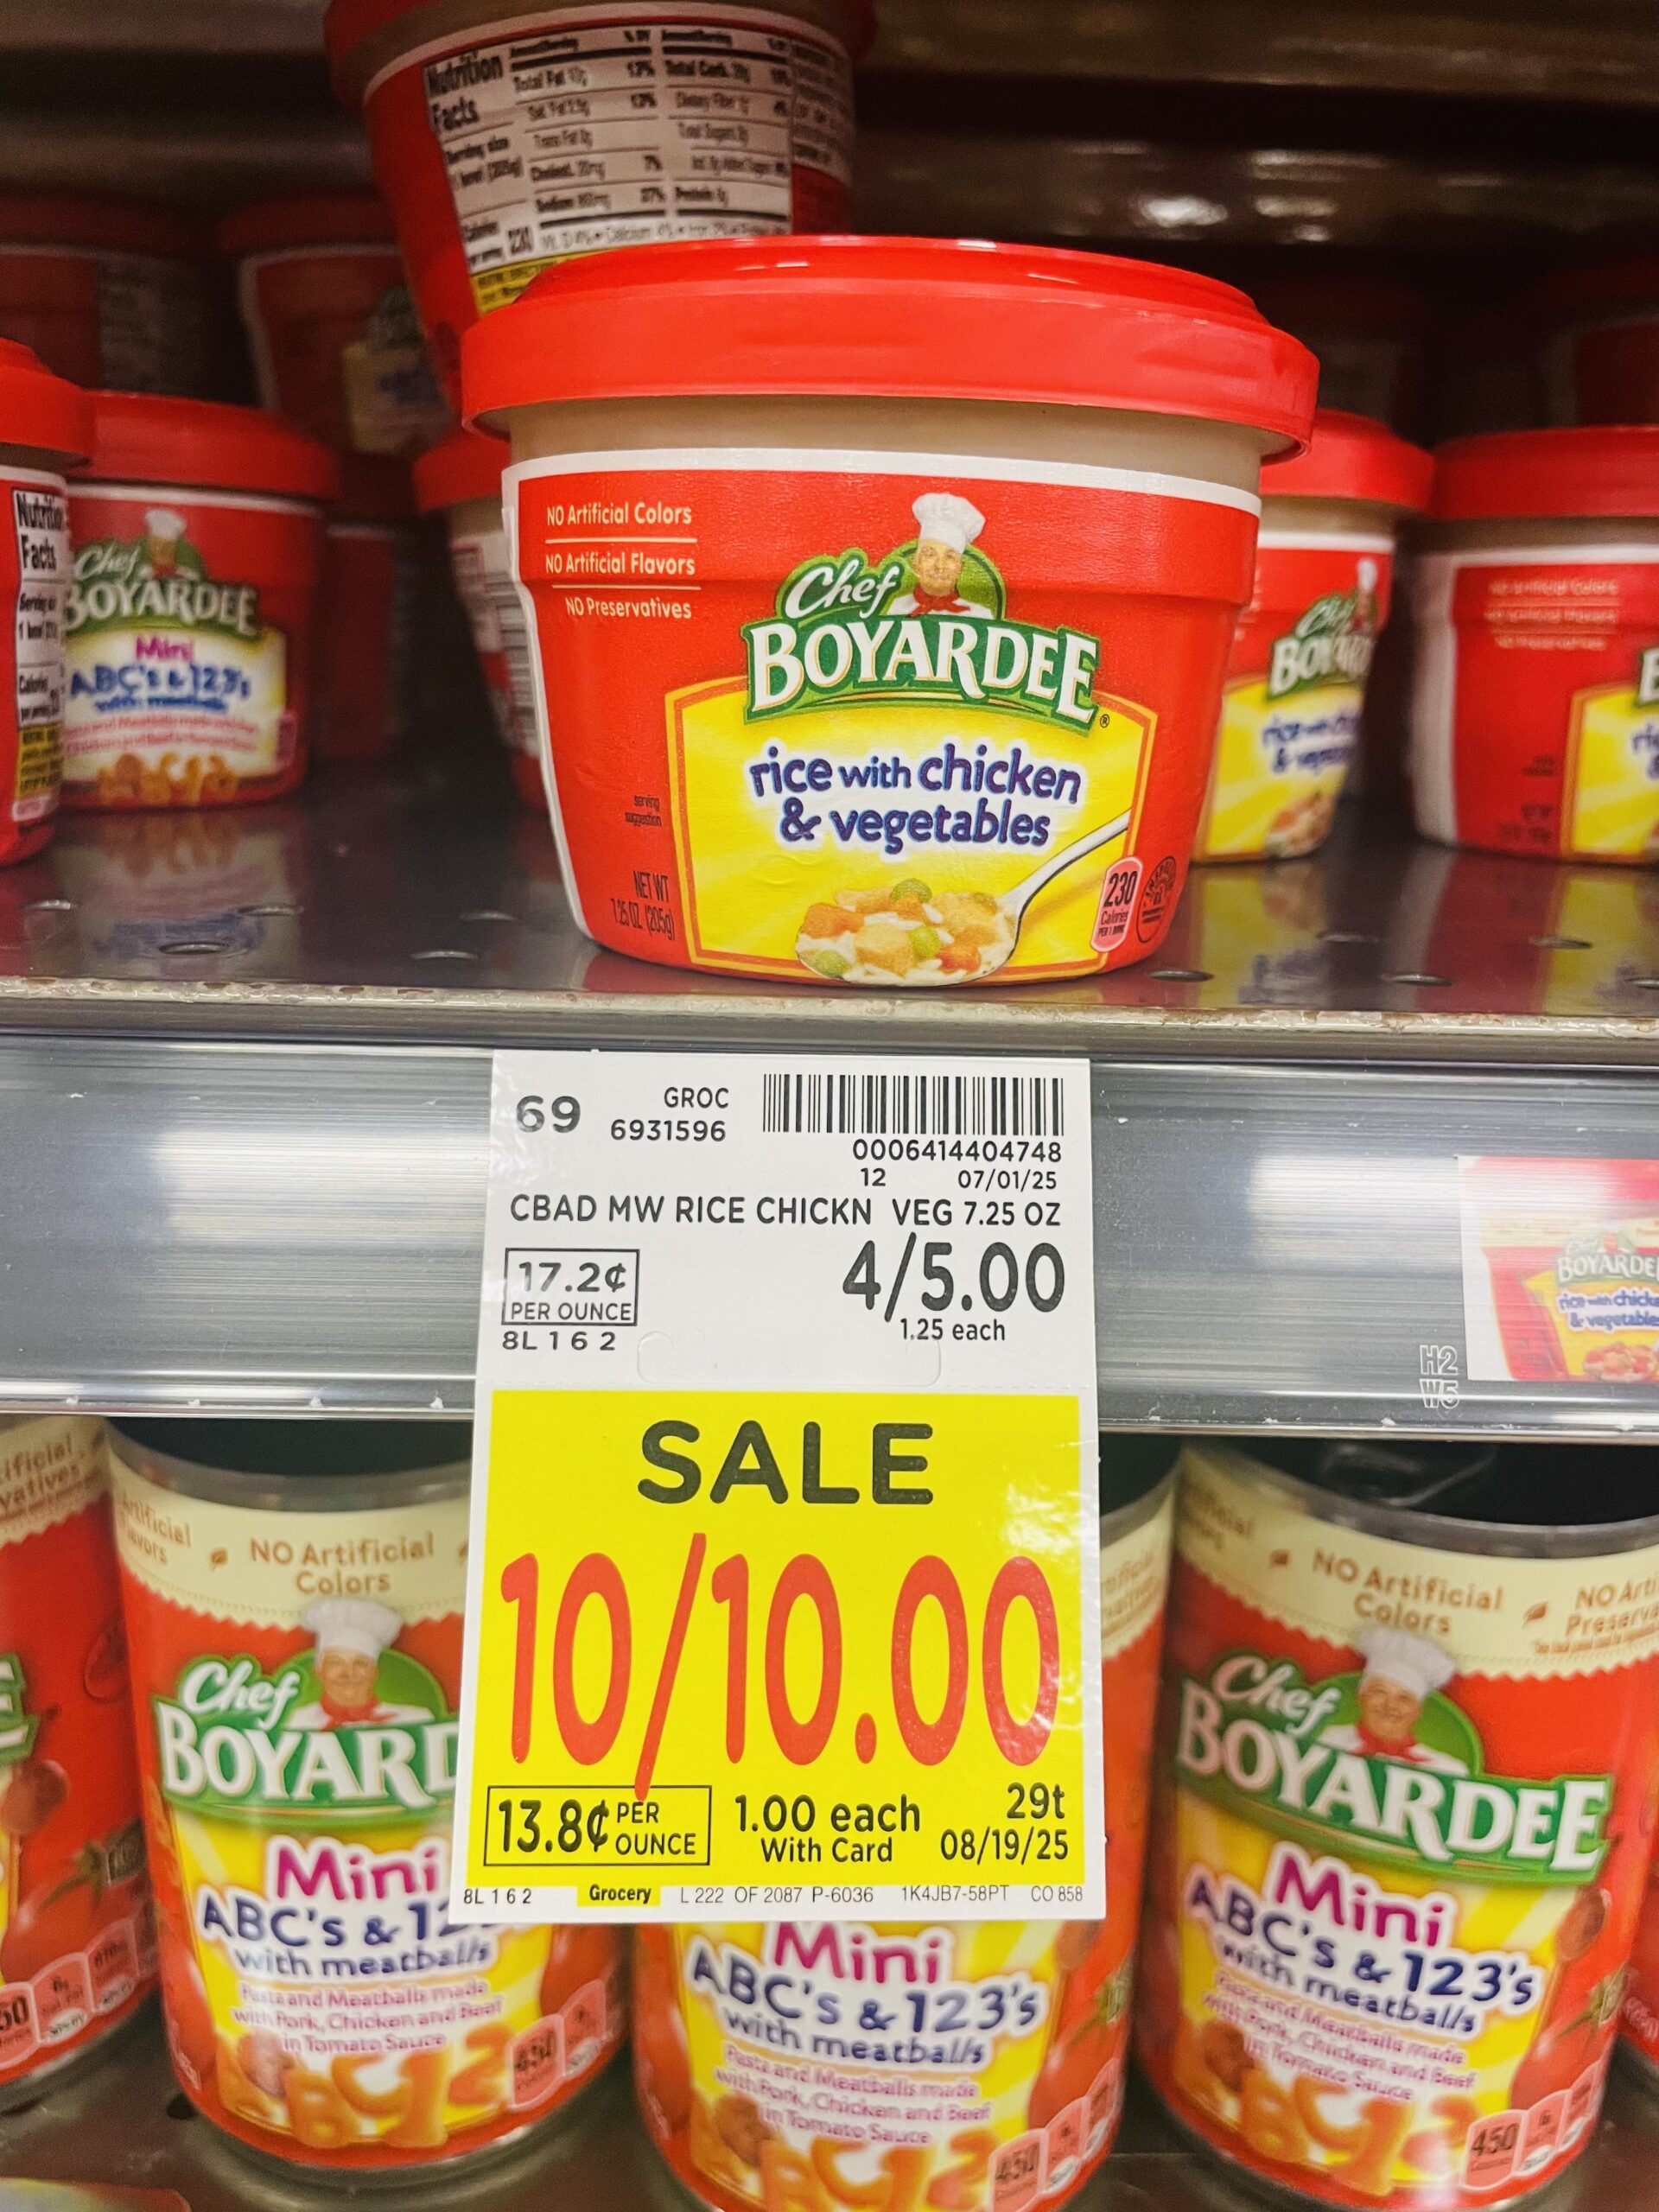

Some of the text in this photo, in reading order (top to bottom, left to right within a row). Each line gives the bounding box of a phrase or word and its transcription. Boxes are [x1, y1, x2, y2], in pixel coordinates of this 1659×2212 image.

[547, 501, 692, 528] NO Artificial Colors
[545, 551, 696, 576] NO Artificial Flavors
[565, 596, 692, 620] NO Preservatives
[785, 563, 899, 620] Chef
[749, 616, 1099, 726] BOYARDEE
[751, 744, 1082, 804] rice with chicken
[633, 794, 660, 811] serving
[779, 797, 1051, 855] & vegetables
[632, 869, 670, 903] NET WT
[1103, 870, 1138, 908] 230
[629, 900, 643, 930] OZ
[645, 904, 676, 941] (205g)
[516, 1095, 581, 1134] 69
[664, 1086, 729, 1109] GROC
[610, 1118, 726, 1142] 6931596
[852, 1138, 1062, 1163] 0006414404748
[860, 1167, 1057, 1193] 12 07/01/25
[510, 1193, 1061, 1227] CBAD MW RICE CHICKN VEG 7.25 OZ
[518, 1261, 626, 1294] 17.2¢
[842, 1231, 1065, 1323] 4/5.00
[511, 1301, 632, 1321] PER OUNCE
[502, 1330, 616, 1351] 8L 1 6 2
[899, 1318, 1006, 1341] 1.25 each
[1420, 1344, 1459, 1376] H2
[637, 1420, 934, 1505] SALE
[249, 1531, 435, 1567] NO Artificial
[296, 1569, 391, 1595] Colors
[1313, 1547, 1504, 1611] NO Artificial
[1354, 1592, 1452, 1635] Colors
[1575, 1583, 1617, 1610] NO
[500, 1532, 1060, 1802] 10/10.00
[184, 1660, 302, 1728] Chef
[1215, 1656, 1342, 1735] Chef
[156, 1700, 461, 1808] BOYARD
[1178, 1678, 1609, 1872] BOYARDEE
[616, 1801, 659, 1824] PER
[734, 1793, 920, 1833] 1.00 each
[1006, 1782, 1065, 1820] 29t
[498, 1799, 610, 1853] 13.8¢
[615, 1833, 696, 1856] OUNCE
[760, 1836, 893, 1863] With Card
[940, 1826, 1069, 1866] 08/19/25
[276, 1846, 439, 1901] Mini
[463, 1887, 531, 1904] 8L 1 6 2
[588, 1884, 652, 1905] Grocery
[680, 1885, 874, 1904] L 222 OF 2087 P-6036
[902, 1884, 1010, 1902] 1K4JB7-58PT
[1031, 1885, 1083, 1903] CO 858
[1275, 1852, 1446, 1948] Mini
[200, 1893, 402, 1948] ABC's &
[774, 1922, 942, 1985] Mini
[1189, 1873, 1535, 2006] ABC's & 123's
[233, 1937, 490, 1977] with meatballs
[284, 1988, 322, 2007] and
[327, 1984, 426, 2007] Meatballs
[692, 1948, 1039, 2034] ABC's & 123's
[1305, 1974, 1477, 2033] meatballs
[327, 2009, 416, 2031] Chicken
[417, 2005, 454, 2024] and
[282, 2032, 446, 2053] in Tomato Sauce
[722, 2005, 987, 2066] with meatballs
[815, 2068, 917, 2097] Meatballs
[812, 2091, 902, 2119] Chicken
[868, 2123, 931, 2145] Sauce
[1470, 2123, 1521, 2158] 450
